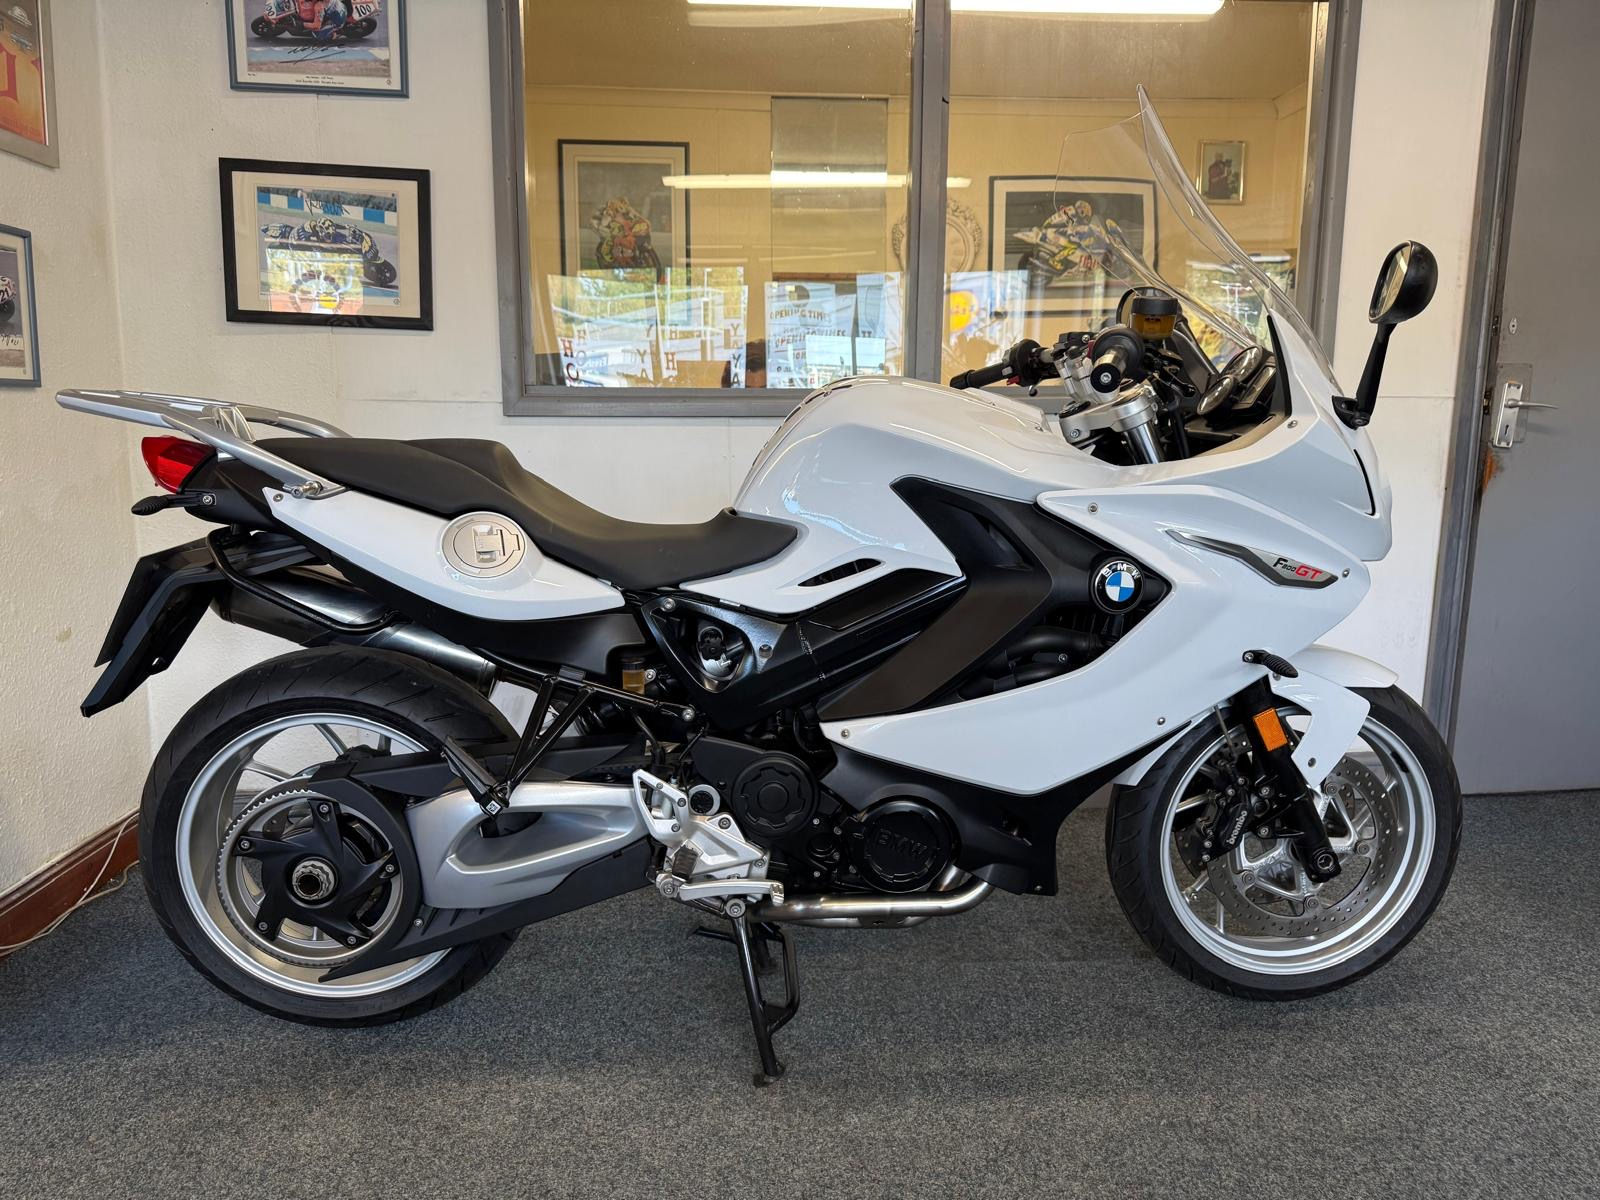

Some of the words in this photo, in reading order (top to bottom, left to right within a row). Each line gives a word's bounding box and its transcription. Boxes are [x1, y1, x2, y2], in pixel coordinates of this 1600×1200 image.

[354, 4, 373, 18] 100
[1101, 562, 1142, 580] BMW
[1225, 809, 1248, 845] brembo
[876, 827, 929, 857] BMW
